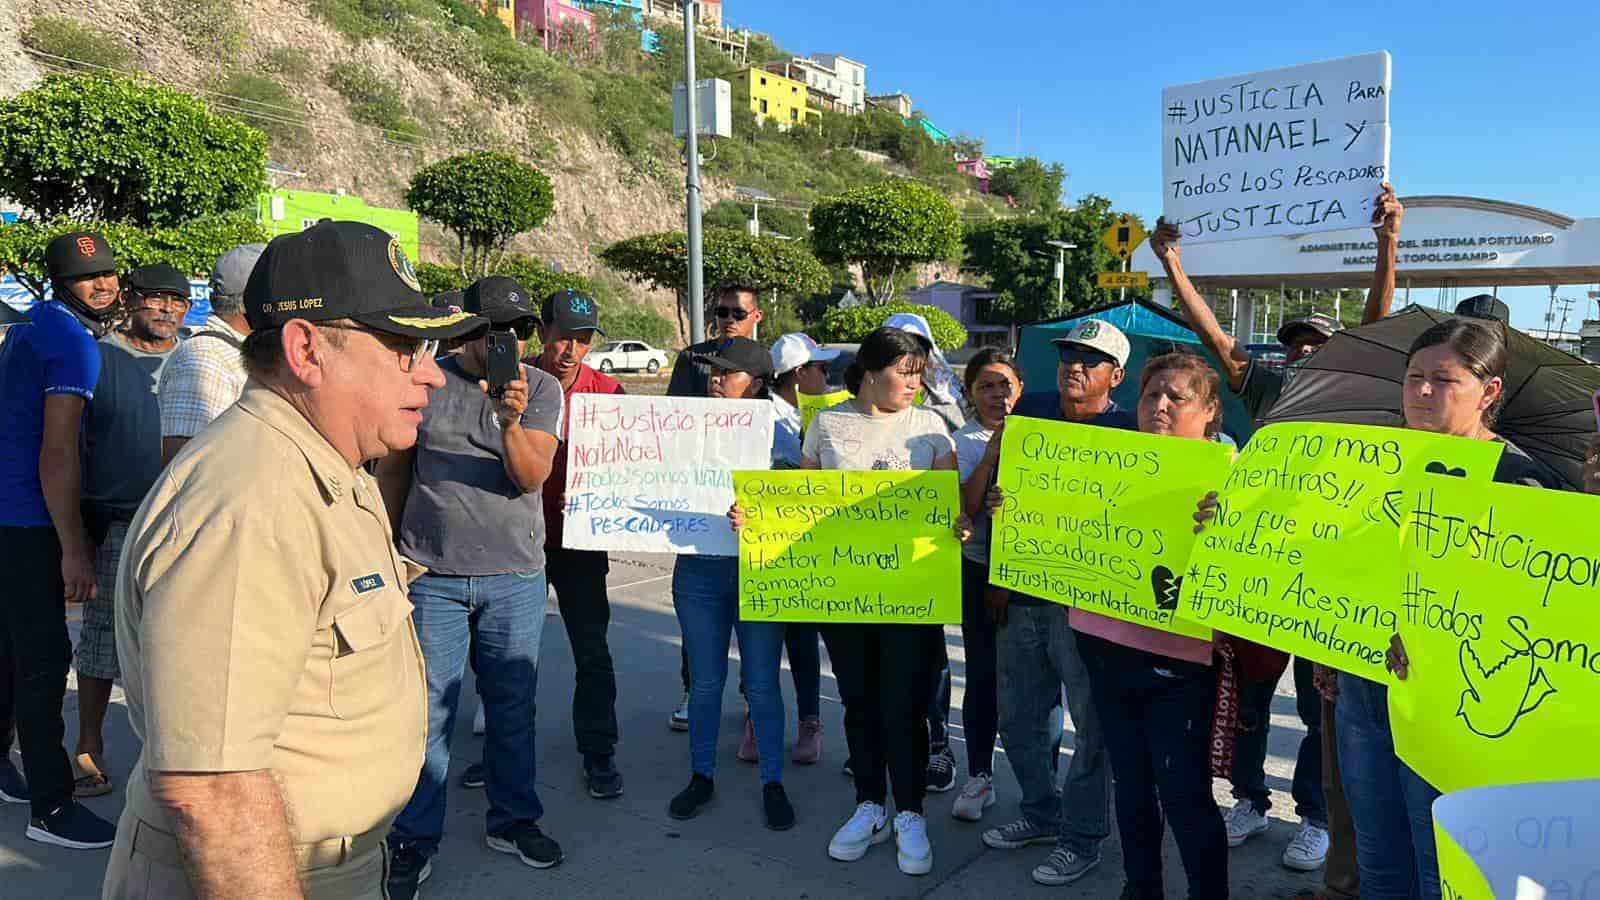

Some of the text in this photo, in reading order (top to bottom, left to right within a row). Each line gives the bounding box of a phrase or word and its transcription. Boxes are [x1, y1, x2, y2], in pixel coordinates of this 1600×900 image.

[1168, 80, 1324, 124] #JUSTICIA
[1174, 118, 1329, 166] NATANAEL
[1176, 199, 1346, 238] JUSTICIA
[1299, 234, 1555, 253] ADMINISTRAC DEL SISTEMA PORTUARIO
[1343, 252, 1498, 265] NACIOL TOPOLOBAMPO
[704, 410, 752, 437] para
[1022, 432, 1160, 476] Queremos
[1290, 434, 1322, 457] no
[1334, 437, 1402, 474] mas
[694, 468, 731, 488] NATA
[743, 474, 938, 500] Que de la Cara
[591, 515, 712, 536] PESCADORES
[744, 501, 953, 528] el responsable del
[1000, 495, 1165, 556] Para nuestros
[1213, 500, 1339, 545] No fue un
[748, 545, 822, 571] Hector
[1001, 526, 1142, 580] Pescadores
[1204, 531, 1303, 566] axidente
[1244, 577, 1268, 596] un
[1401, 571, 1483, 641] #Todos
[1188, 591, 1389, 665] #JusticiaporNatanae
